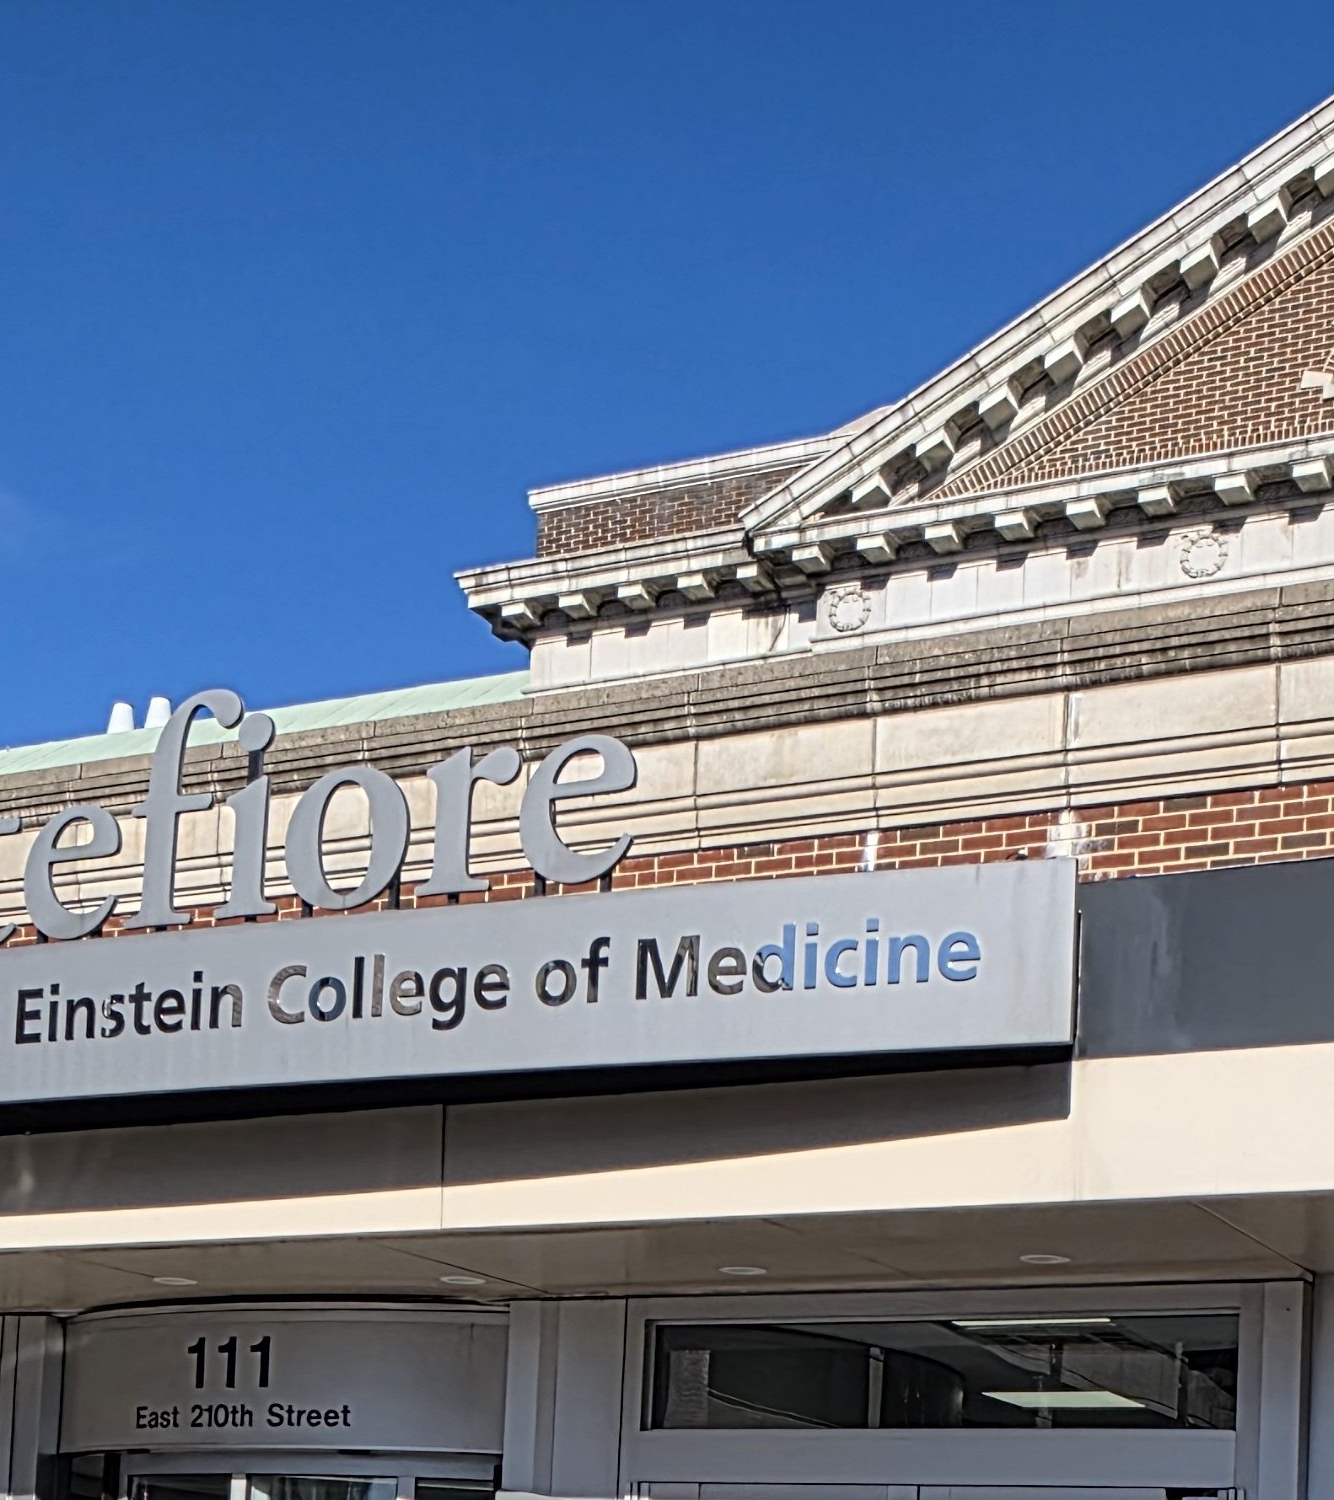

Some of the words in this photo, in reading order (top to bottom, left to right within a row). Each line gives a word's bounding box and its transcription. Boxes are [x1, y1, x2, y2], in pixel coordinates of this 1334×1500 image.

[15, 970, 243, 1044] Einstein
[268, 953, 510, 1030] College
[536, 936, 610, 1006] of
[637, 918, 982, 1000] Medicine
[187, 1335, 271, 1389] 111
[135, 1406, 180, 1430] East
[191, 1404, 253, 1429] 210th
[267, 1403, 351, 1428] Street
